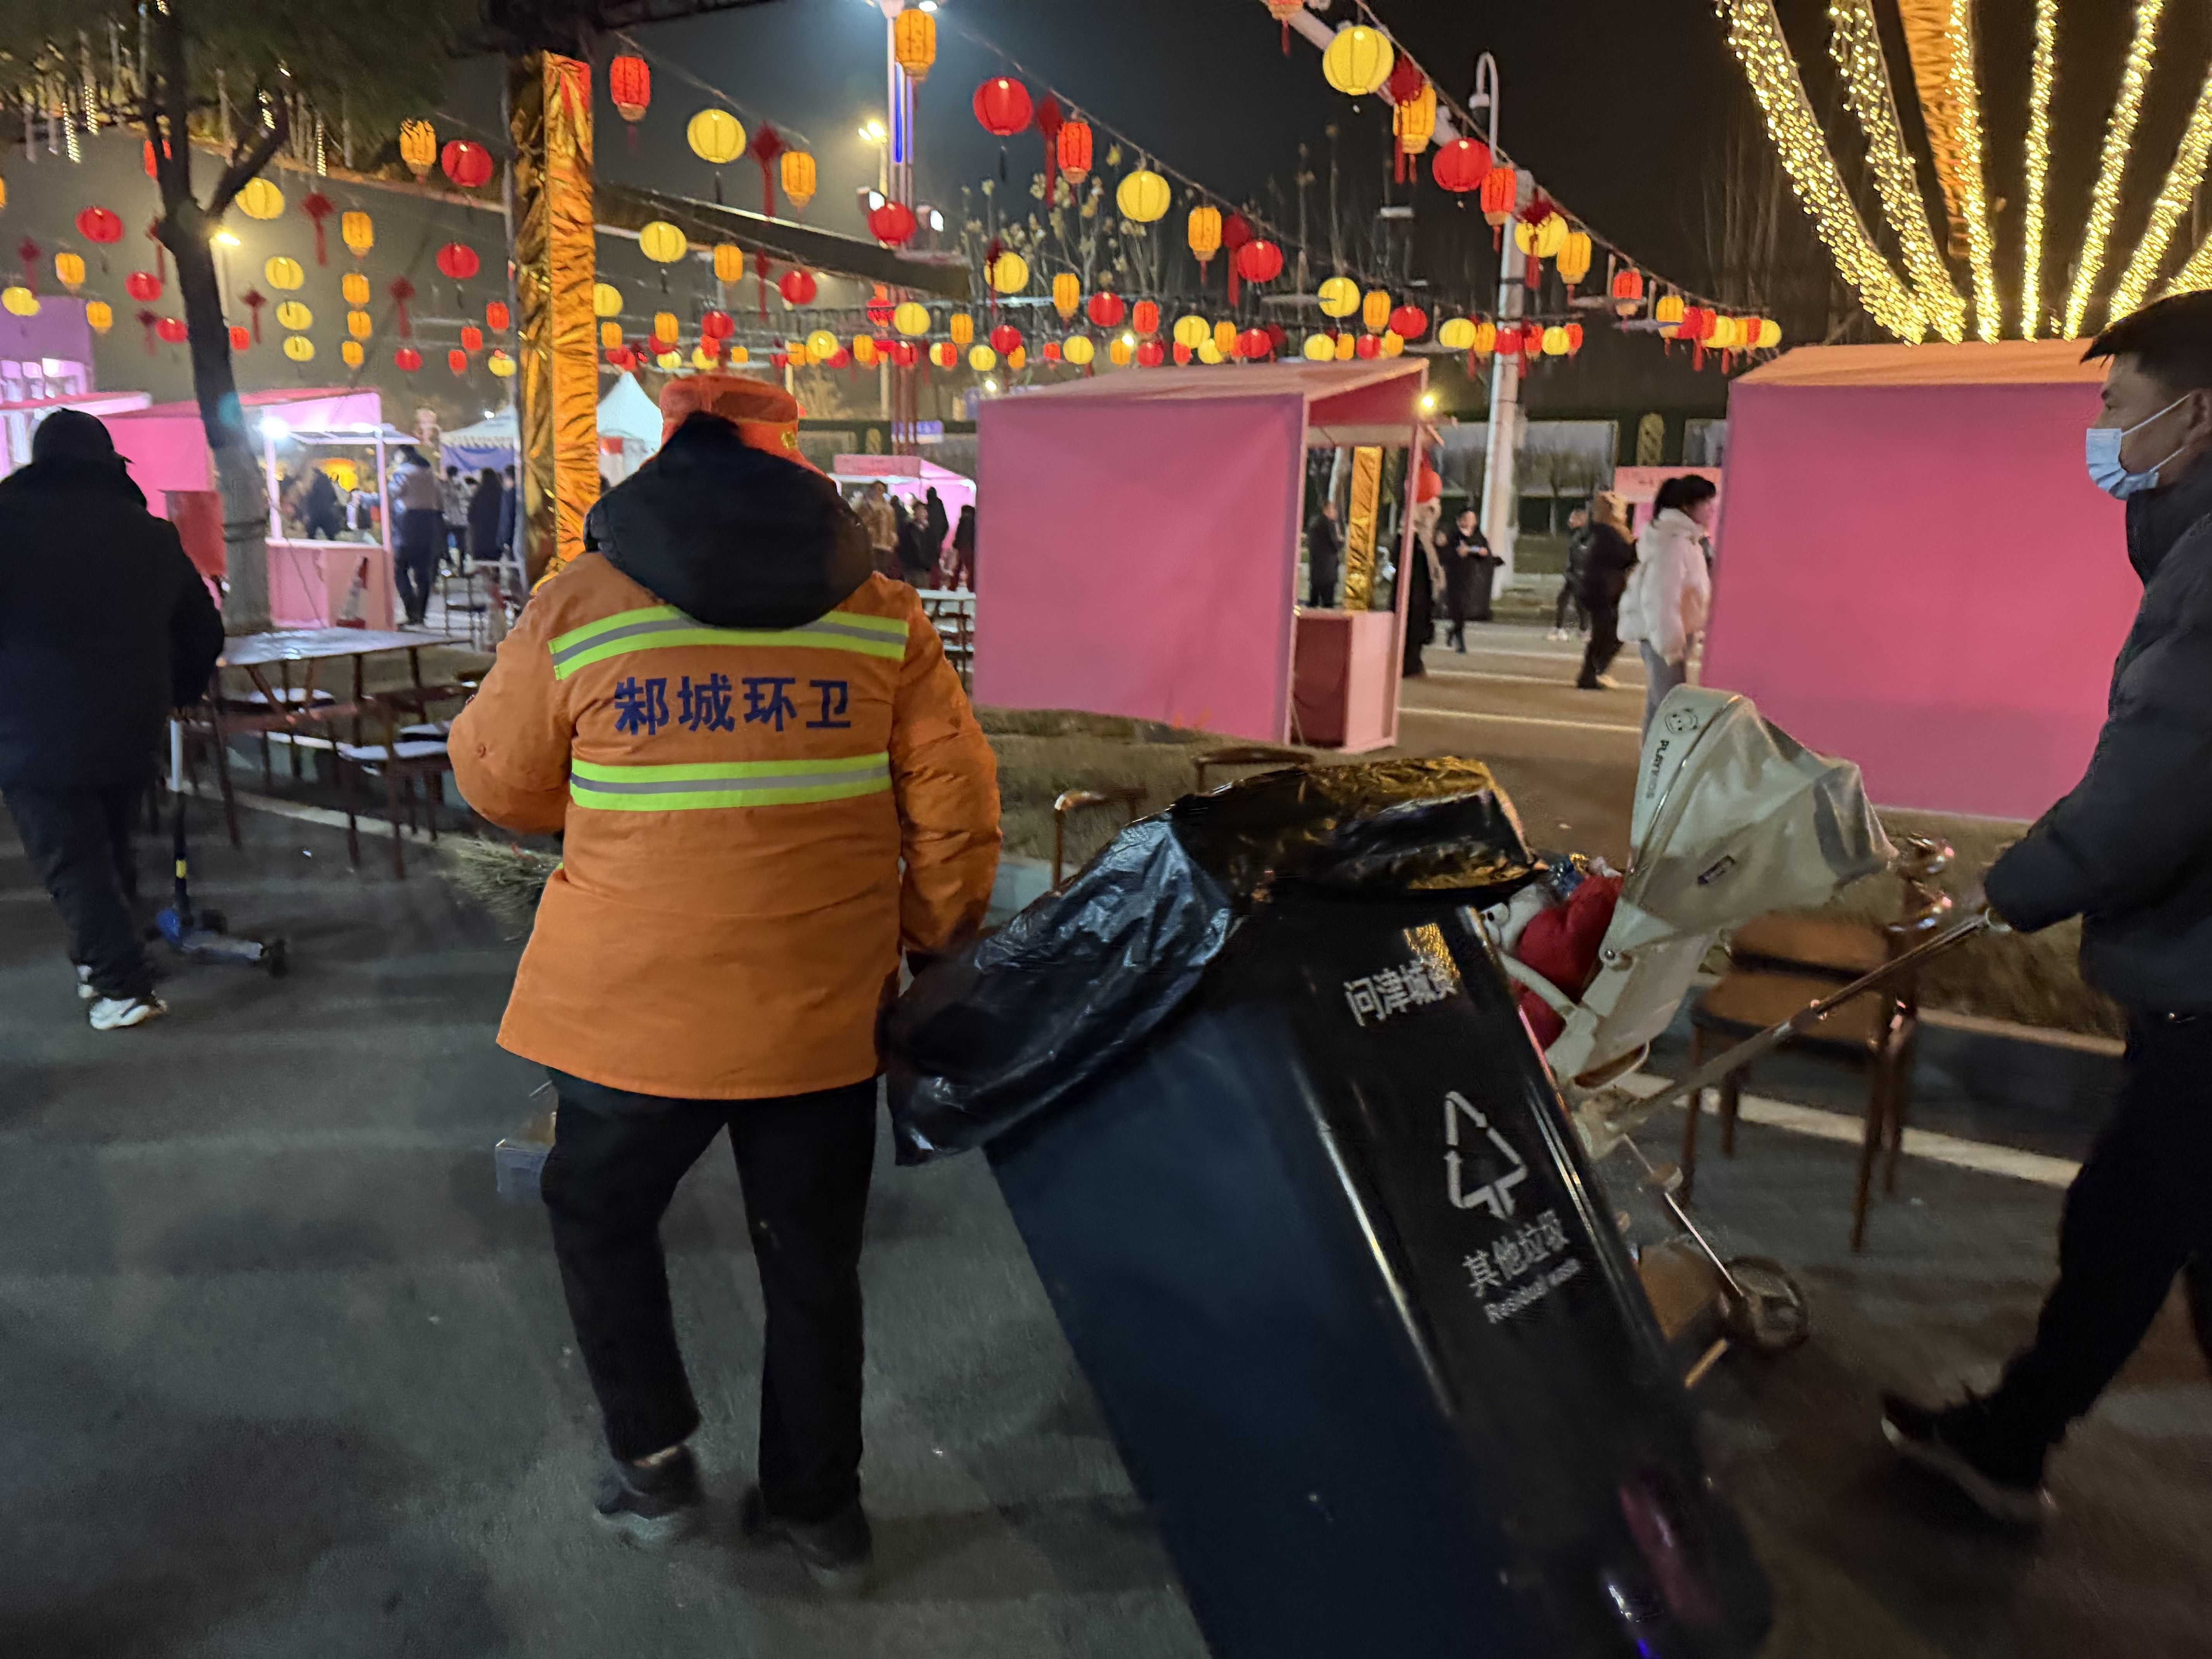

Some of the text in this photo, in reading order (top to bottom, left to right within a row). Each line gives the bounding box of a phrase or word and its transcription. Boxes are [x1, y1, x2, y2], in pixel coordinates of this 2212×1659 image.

[614, 673, 851, 735] 邾城环卫
[1462, 1209, 1570, 1297] 其他垃圾
